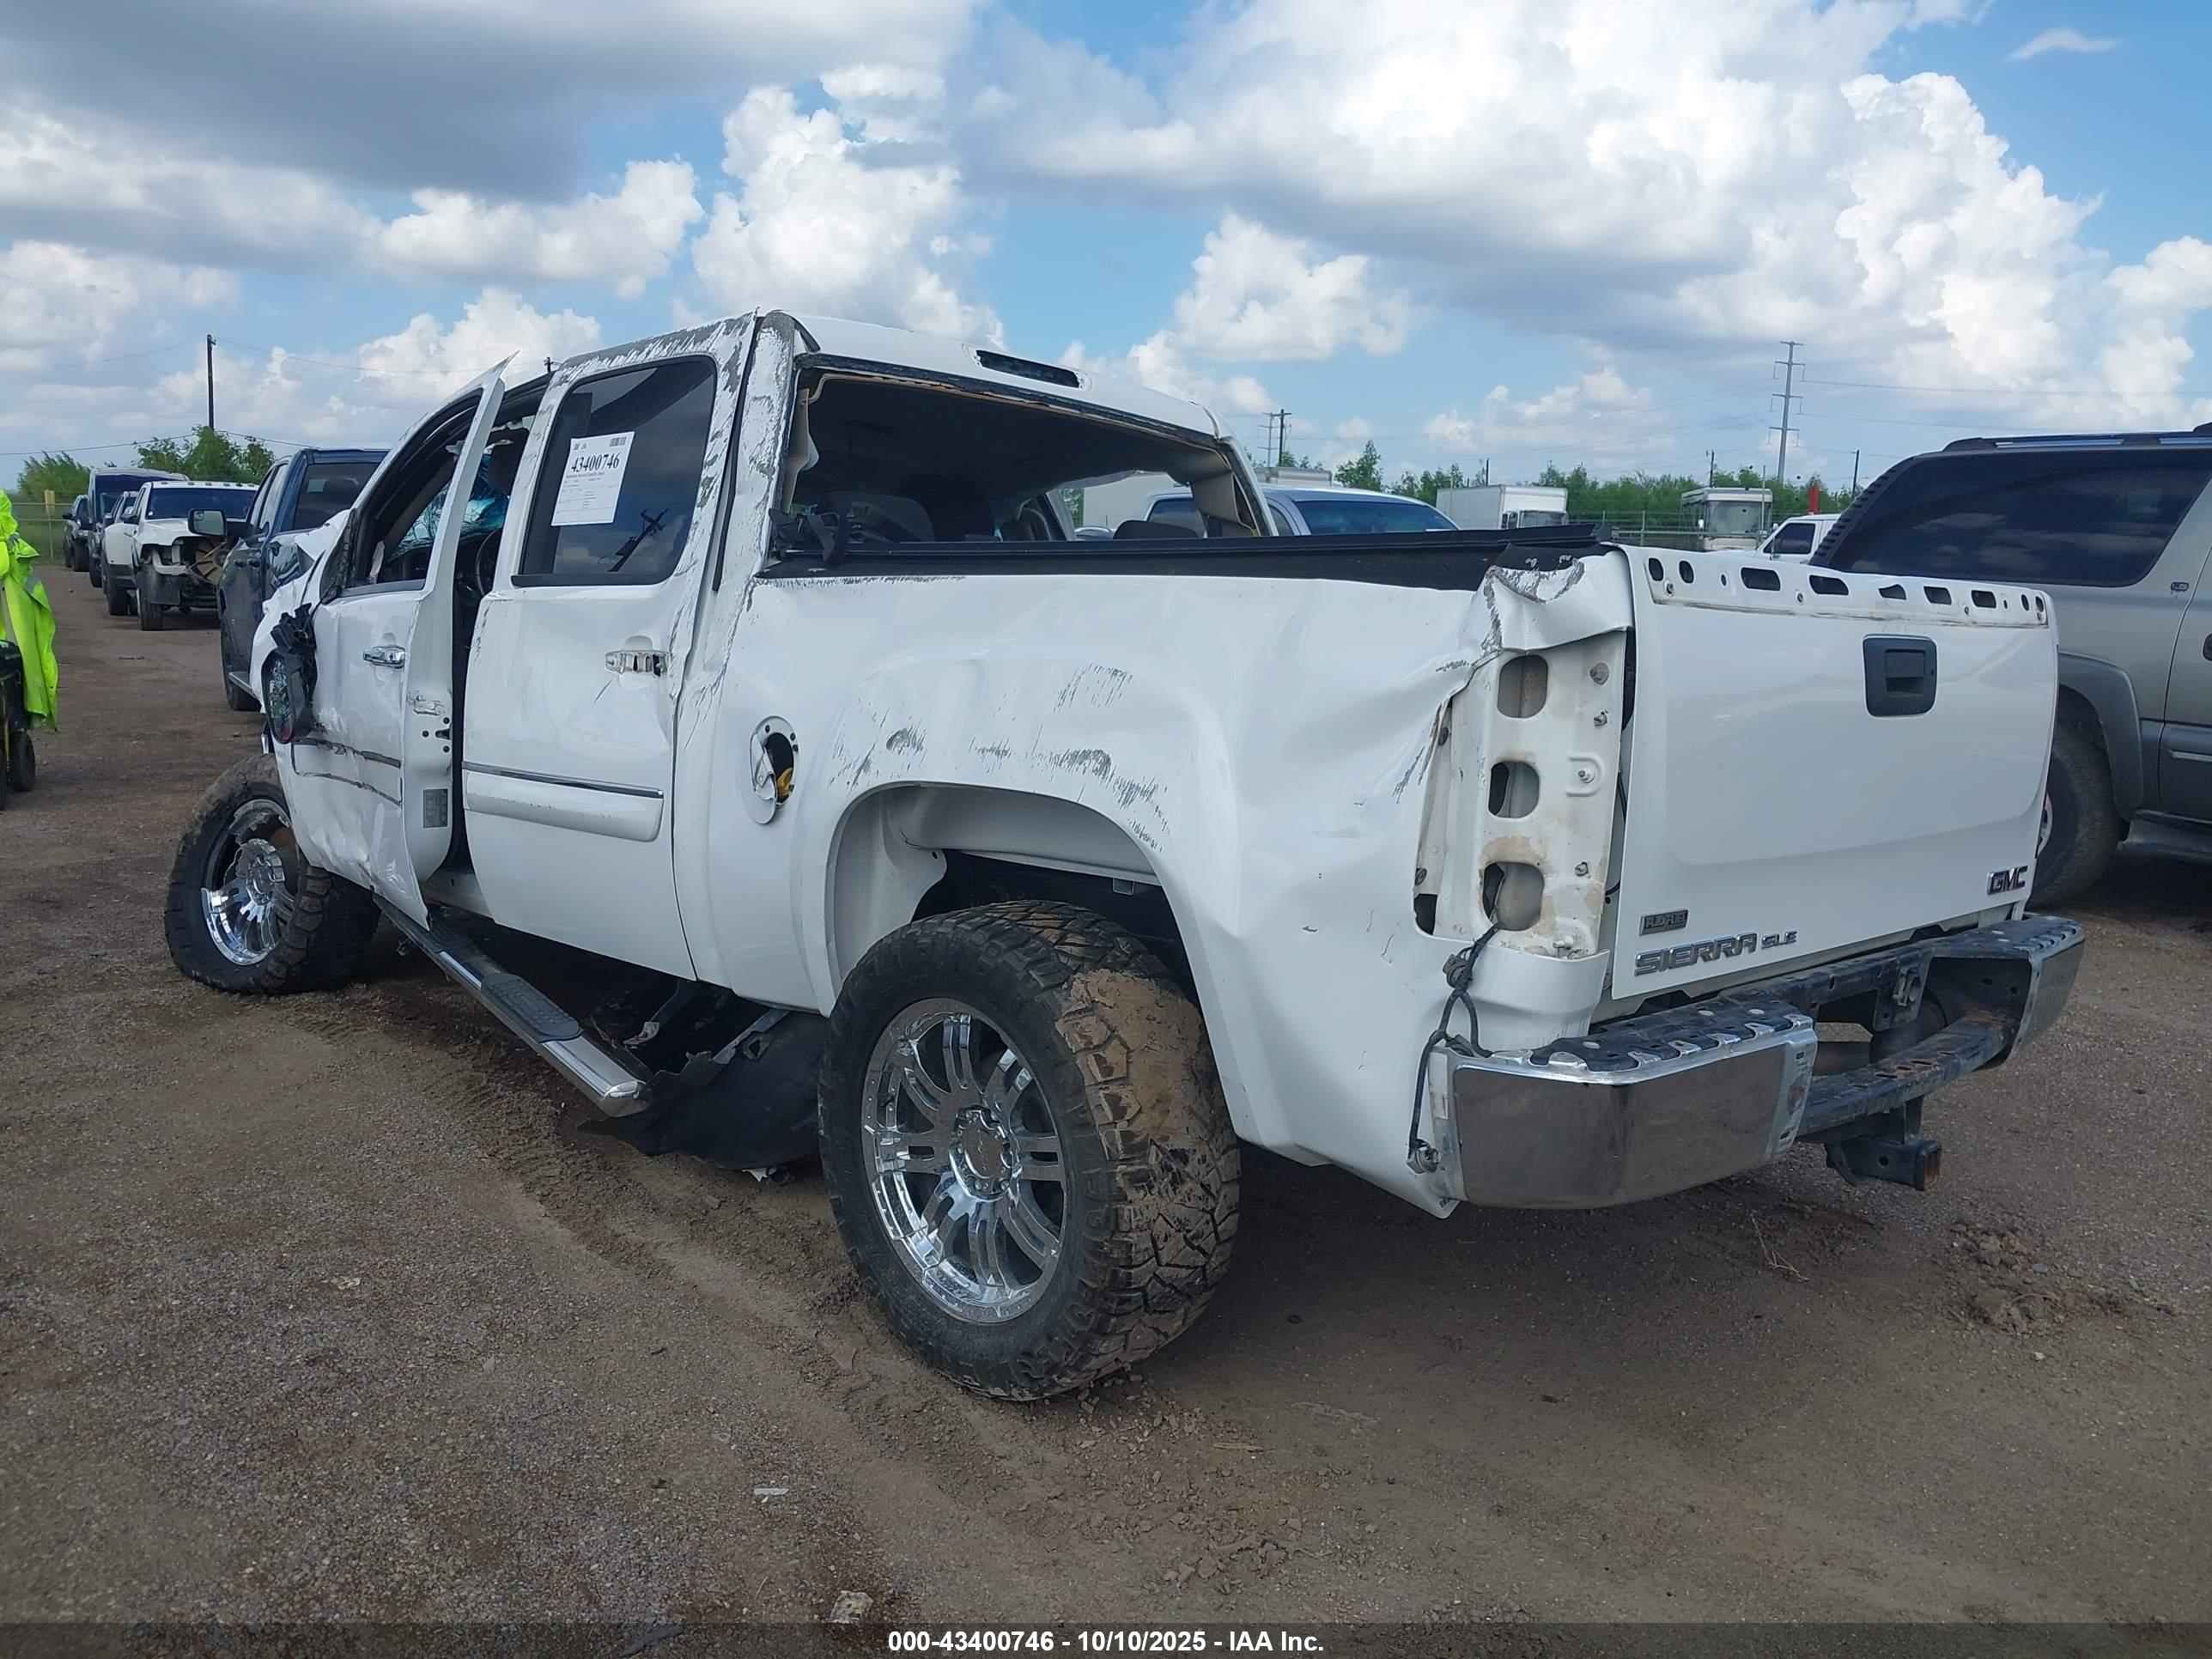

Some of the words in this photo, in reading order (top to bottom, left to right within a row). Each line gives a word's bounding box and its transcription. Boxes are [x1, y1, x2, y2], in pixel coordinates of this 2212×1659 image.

[571, 453, 621, 472] 43400746
[1986, 865, 2028, 895] GMC
[1634, 930, 1758, 976] SIERRA
[1761, 931, 1798, 950] SLE
